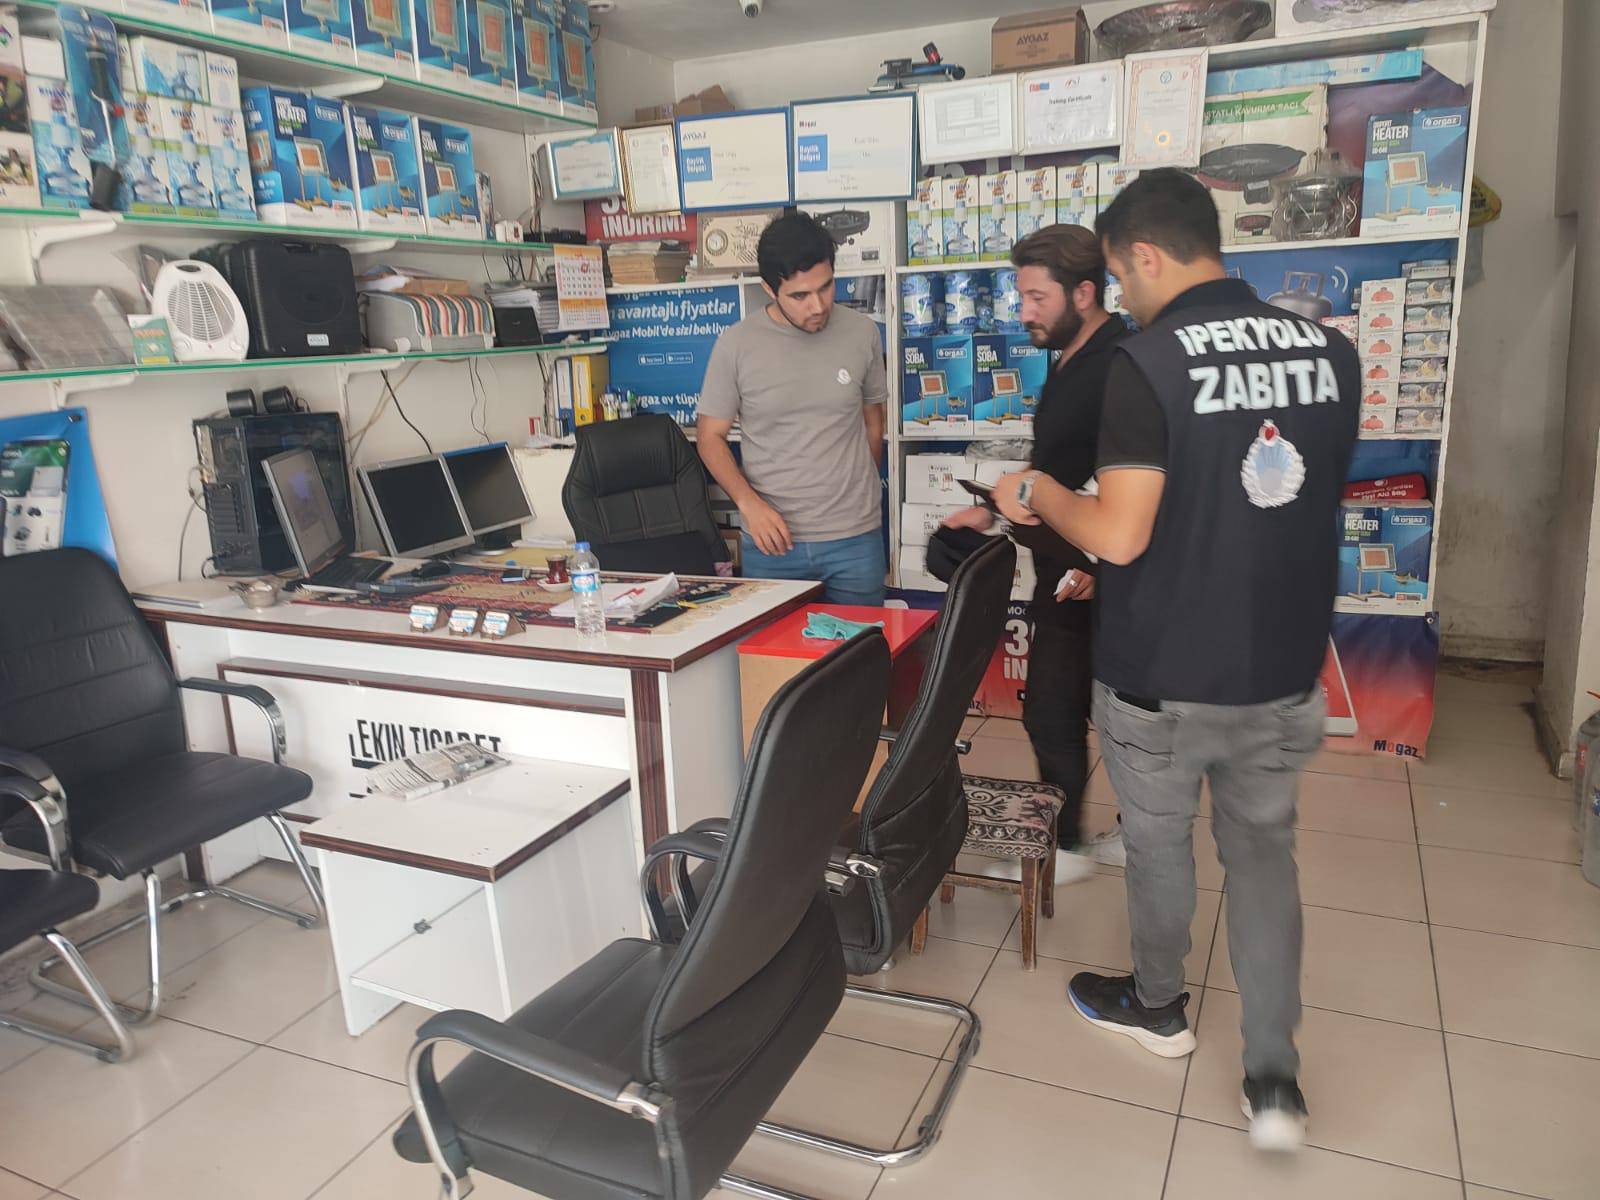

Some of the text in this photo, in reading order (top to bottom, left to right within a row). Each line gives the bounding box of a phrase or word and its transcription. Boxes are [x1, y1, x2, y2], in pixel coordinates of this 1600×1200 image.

[1432, 117, 1457, 127] orgaz
[1372, 125, 1409, 141] HEATER
[618, 301, 679, 322] avantajlı
[680, 299, 736, 321] fiyatlar
[632, 324, 674, 337] Mobil'de
[905, 352, 925, 364] SOBA
[977, 350, 998, 362] SOBA
[1188, 357, 1341, 415] ZABITA
[1345, 520, 1379, 531] HEATER
[1374, 739, 1418, 758] Mogaz
